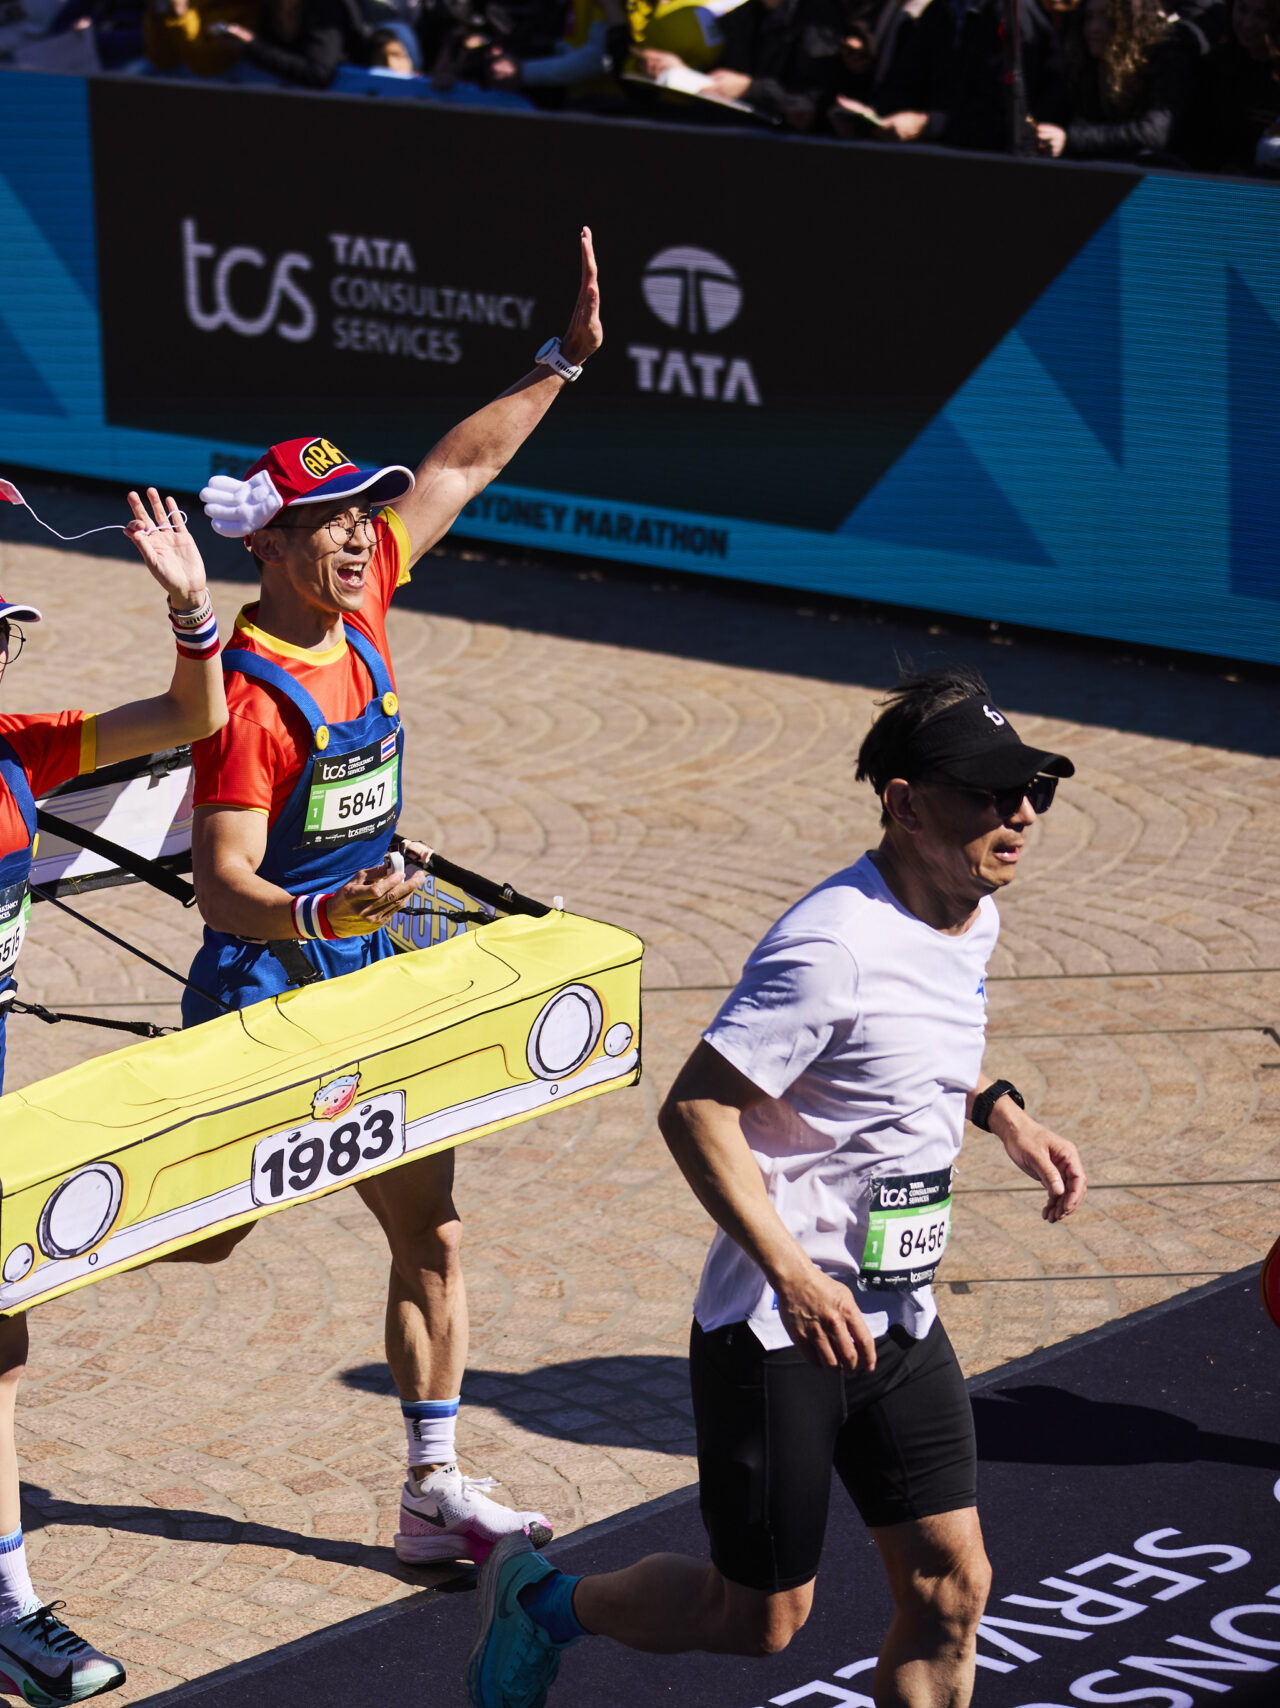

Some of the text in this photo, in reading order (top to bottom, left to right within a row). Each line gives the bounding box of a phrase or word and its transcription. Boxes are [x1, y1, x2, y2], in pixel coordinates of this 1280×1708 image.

[329, 233, 415, 272] TATA
[180, 217, 316, 343] tcs
[330, 275, 537, 329] CONSULTANCY
[332, 316, 462, 363] SERVICES
[628, 345, 761, 405] TATA
[574, 506, 731, 560] MARATHON
[322, 763, 346, 780] tcs
[338, 782, 385, 819] 5847
[261, 1109, 394, 1198] 1983
[880, 1185, 907, 1207] tcs
